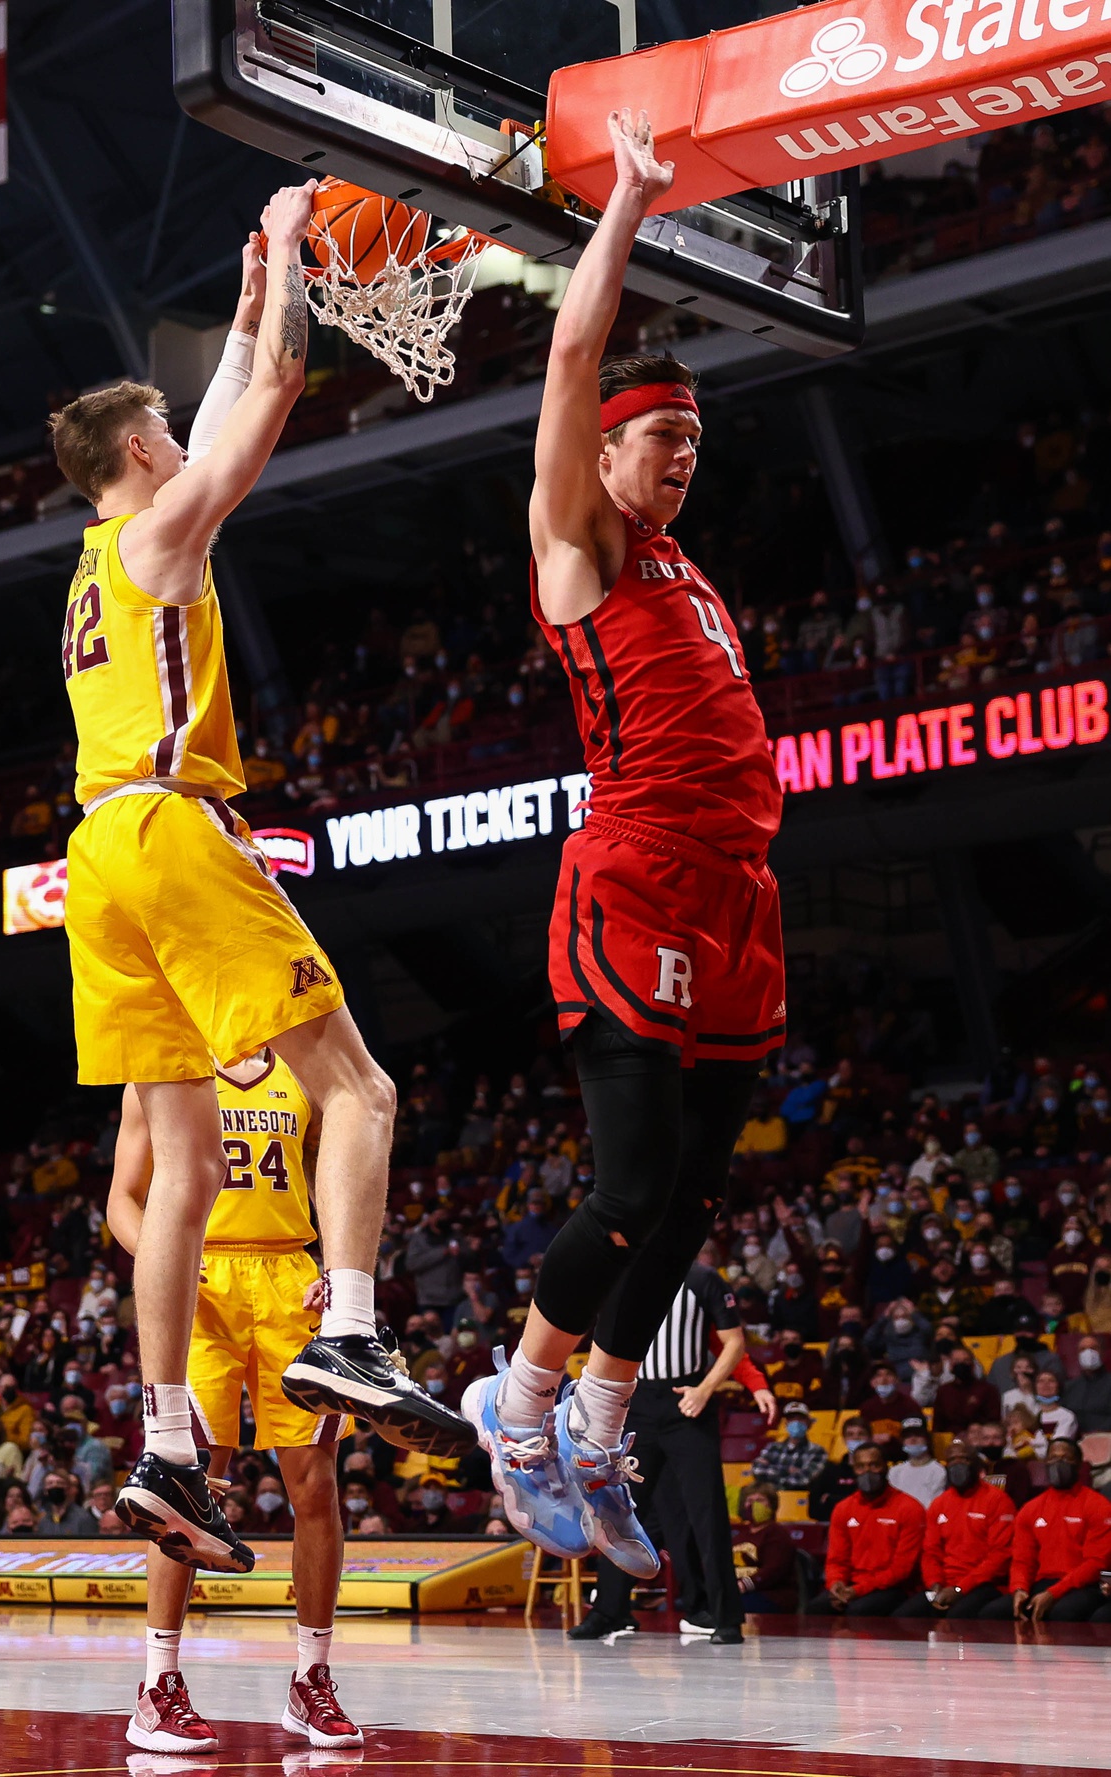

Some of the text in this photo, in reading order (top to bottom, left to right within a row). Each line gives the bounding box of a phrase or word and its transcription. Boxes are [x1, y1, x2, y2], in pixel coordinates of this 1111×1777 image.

[893, 0, 1111, 73] State
[62, 582, 111, 681] 42
[687, 592, 744, 680] 4
[769, 680, 1109, 794] AN PLATE CLUB
[326, 805, 420, 869] YOUR
[425, 780, 557, 852] TICKET
[561, 772, 589, 829] T
[290, 954, 334, 998] M
[654, 946, 693, 1009] R
[218, 1109, 298, 1137] NNESOTA
[222, 1139, 290, 1191] 24
